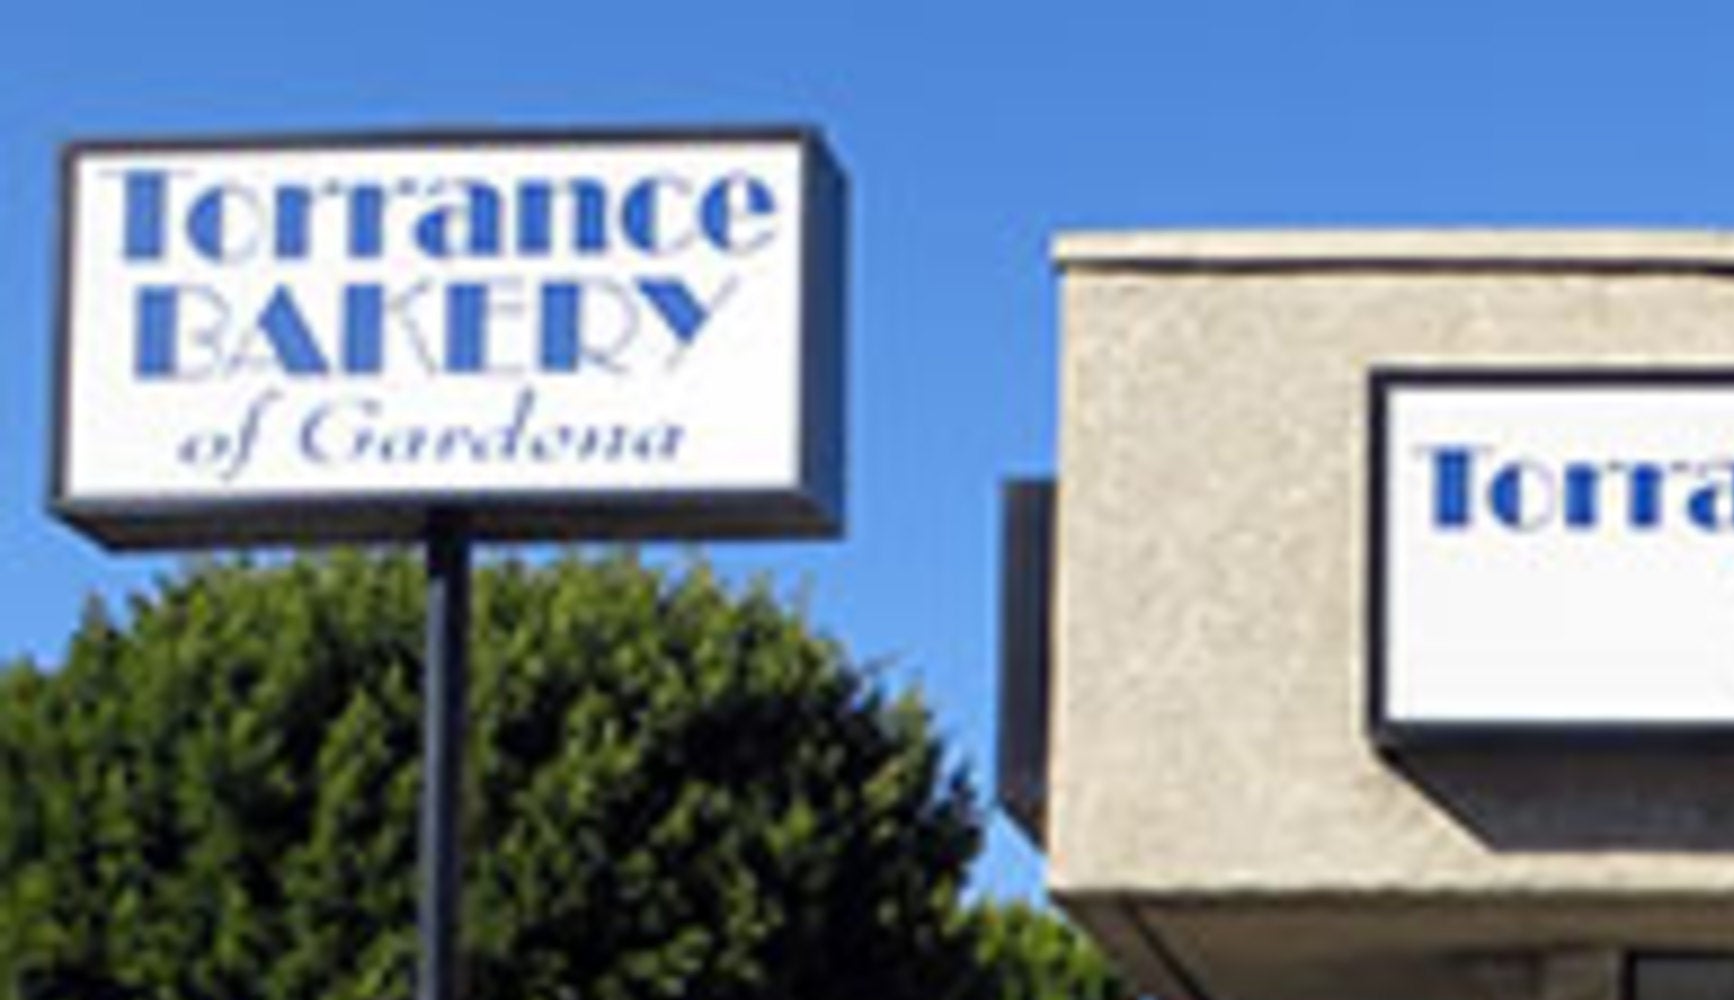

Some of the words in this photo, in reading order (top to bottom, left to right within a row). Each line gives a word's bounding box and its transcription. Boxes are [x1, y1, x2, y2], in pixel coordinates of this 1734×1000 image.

[98, 166, 781, 263] Torrance
[132, 275, 738, 382] BAKERY
[178, 387, 282, 482] of
[297, 386, 686, 463] Gardena
